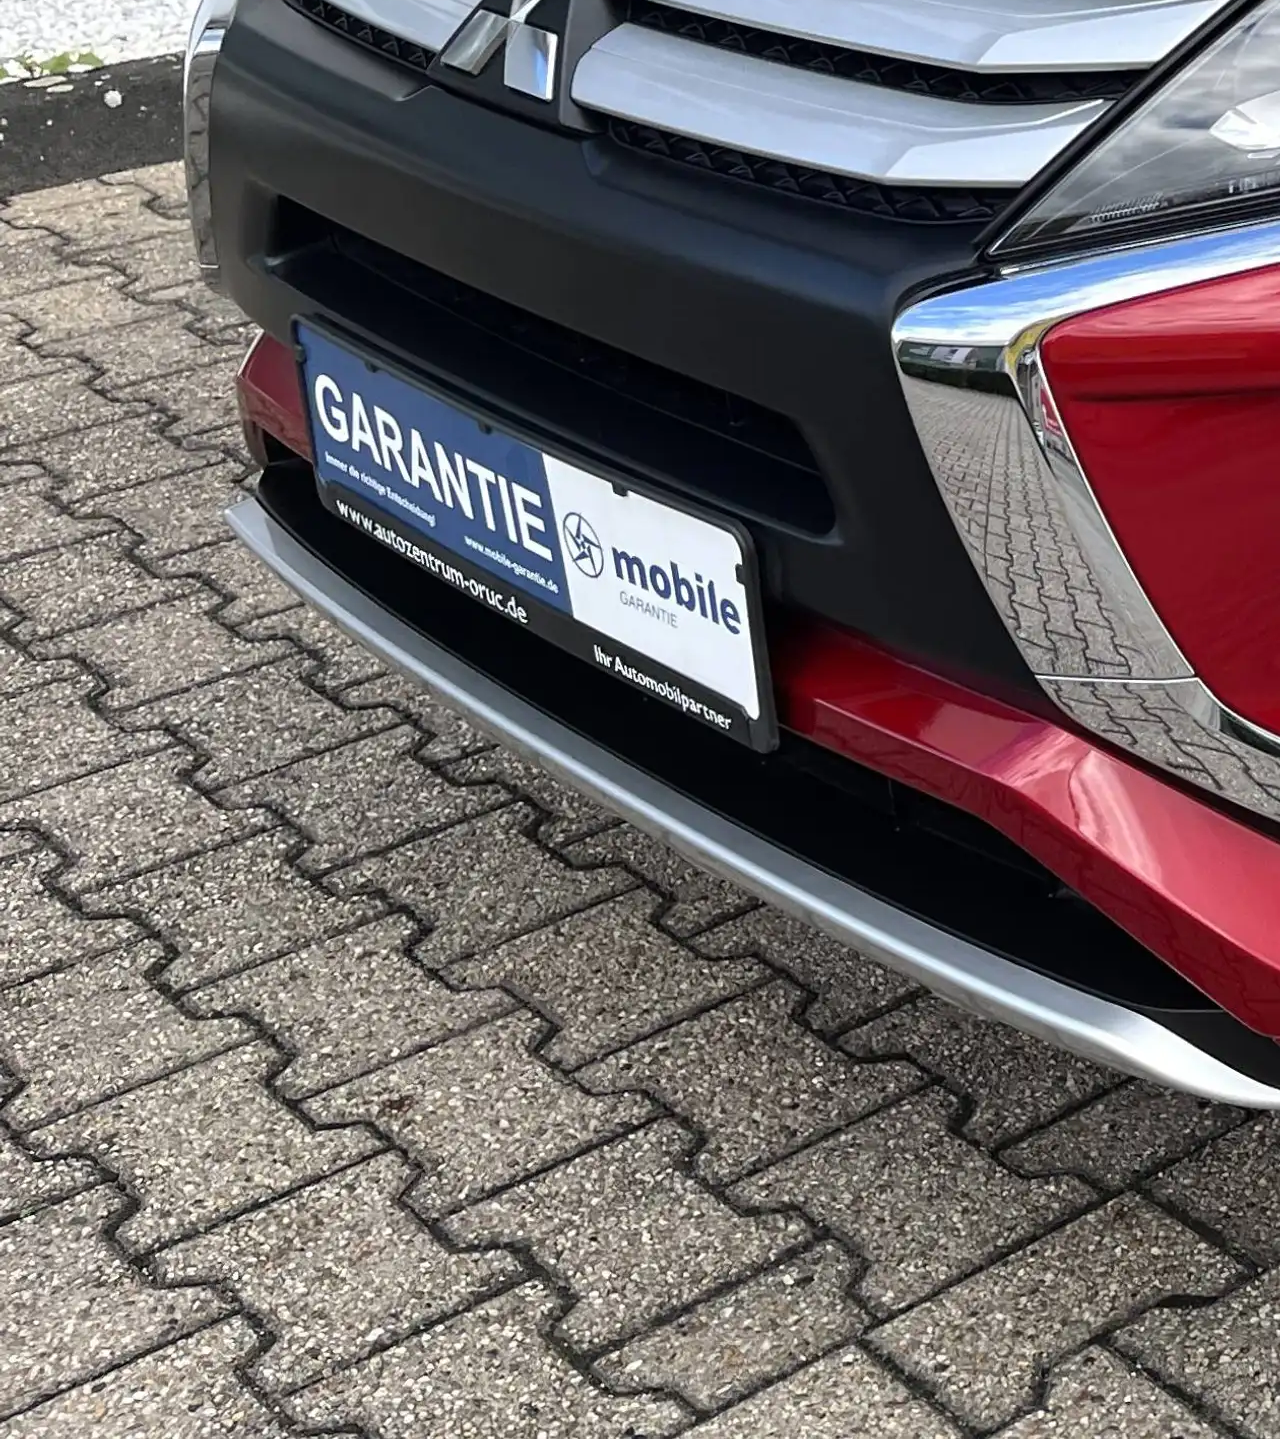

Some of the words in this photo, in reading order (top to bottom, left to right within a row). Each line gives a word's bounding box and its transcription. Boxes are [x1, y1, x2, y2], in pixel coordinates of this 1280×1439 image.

[314, 373, 554, 562] GARANTIE
[360, 472, 386, 496] richtige
[336, 499, 529, 624] www.autozentrum-oruc.de
[463, 535, 559, 595] www.mobile-garantie.de
[611, 546, 741, 635] mobile
[619, 590, 679, 629] GARANTIE
[593, 643, 613, 668] Ihr
[613, 655, 732, 731] Automobilpartner
